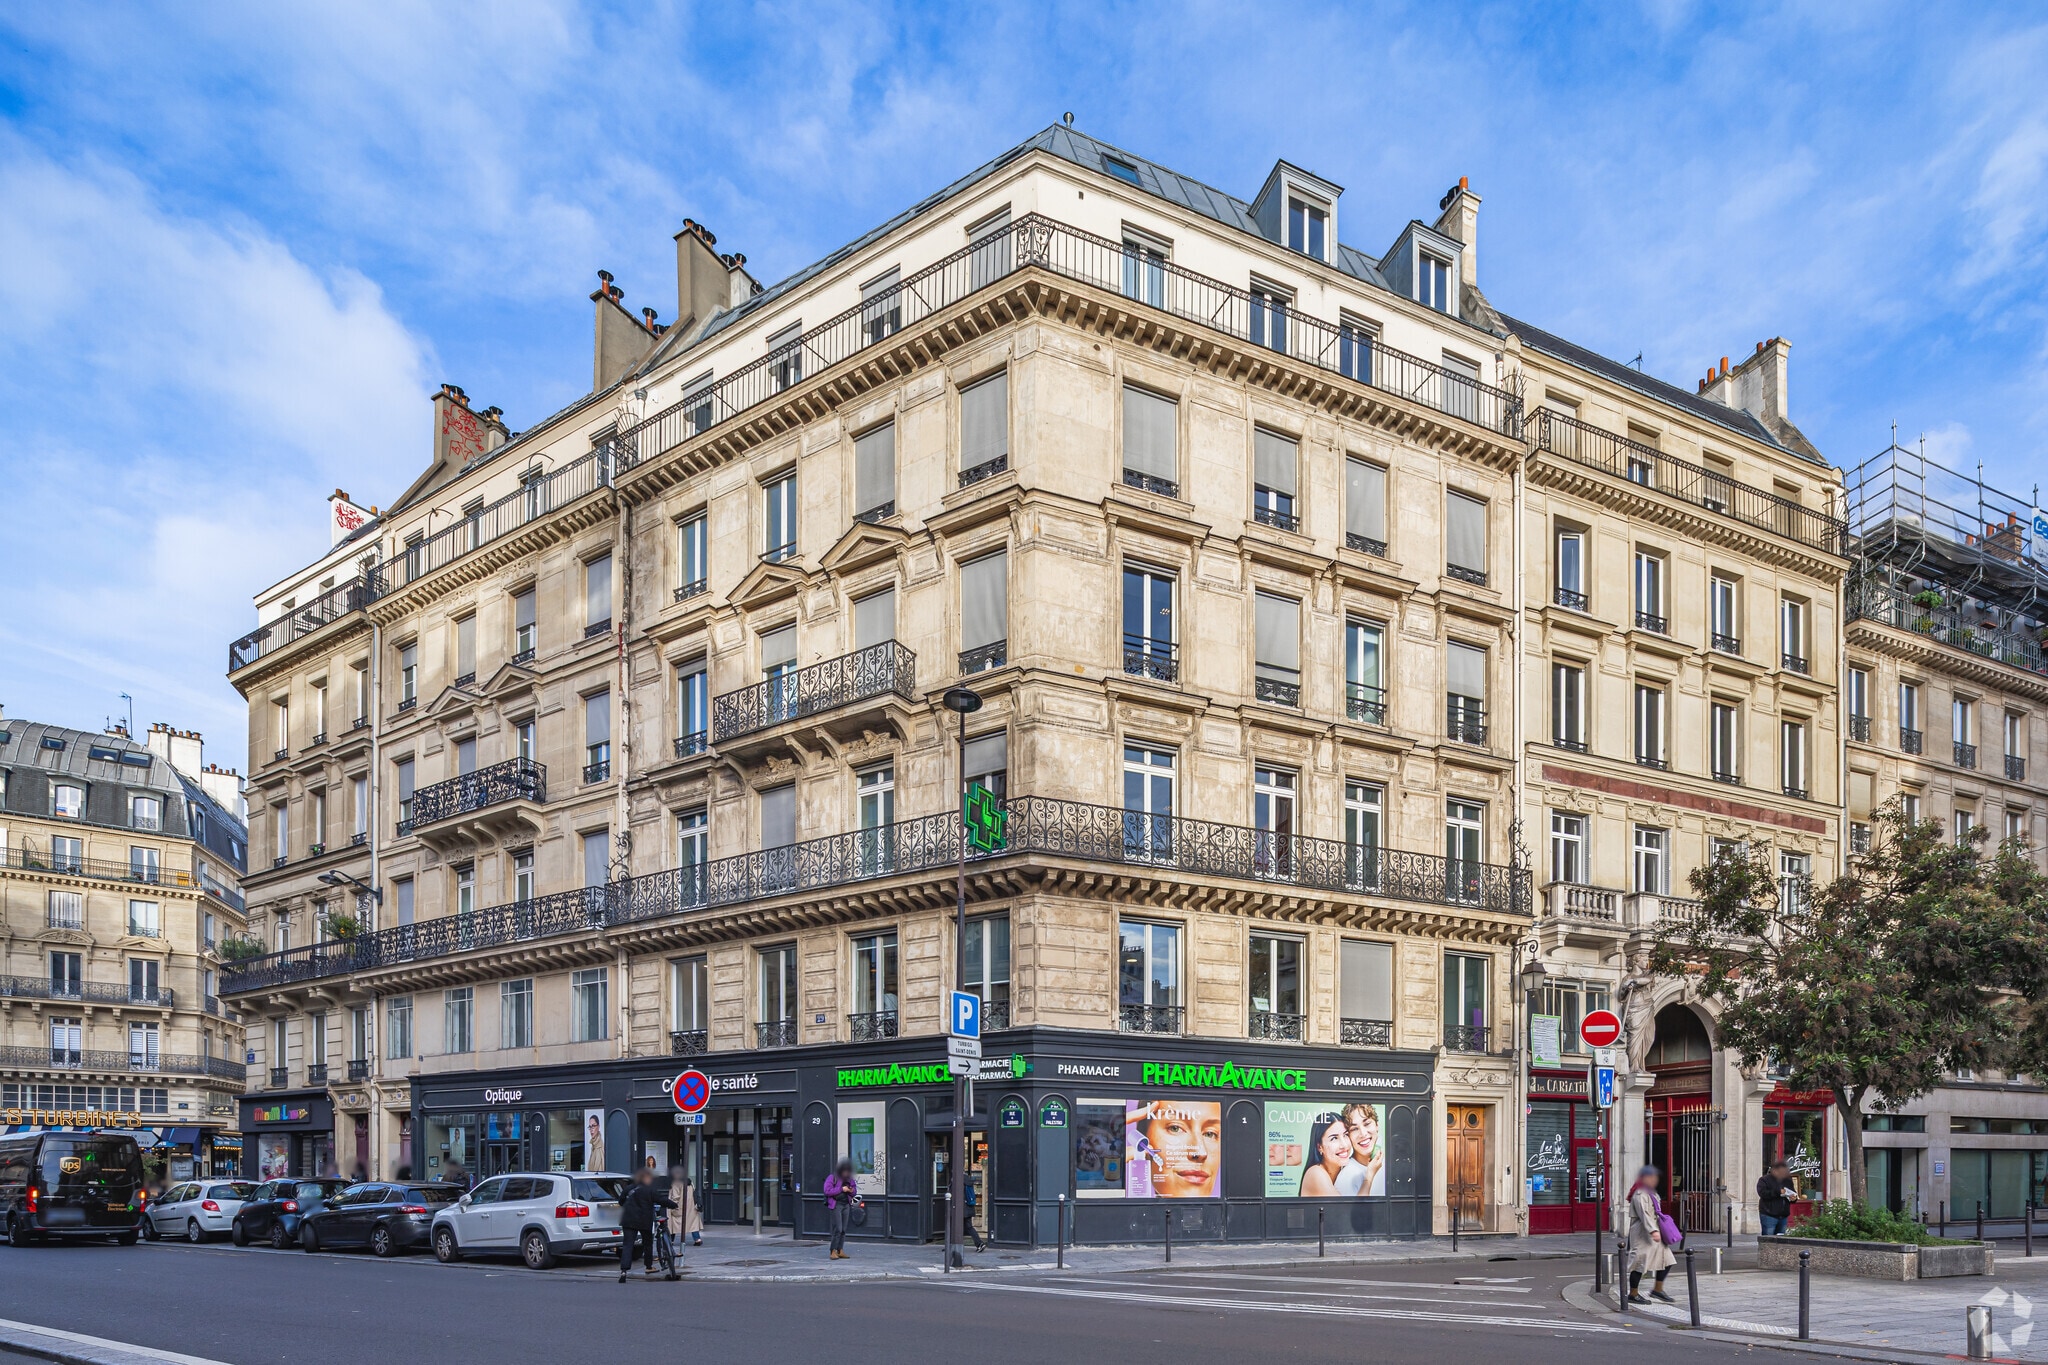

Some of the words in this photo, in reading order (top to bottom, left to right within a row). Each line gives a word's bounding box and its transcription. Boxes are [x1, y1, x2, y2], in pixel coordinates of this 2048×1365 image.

[959, 998, 973, 1030] P
[1057, 1063, 1120, 1076] PHARMACIE
[1142, 1061, 1307, 1091] PHARMAVANCE
[722, 1073, 758, 1089] santé
[1333, 1076, 1405, 1088] PARAPHARMACIE
[485, 1088, 522, 1104] Optique
[27, 1108, 142, 1127] TURBINES
[677, 1115, 695, 1123] SAUF
[1146, 1102, 1201, 1120] krème
[812, 1117, 820, 1125] 29
[61, 1161, 80, 1171] ups
